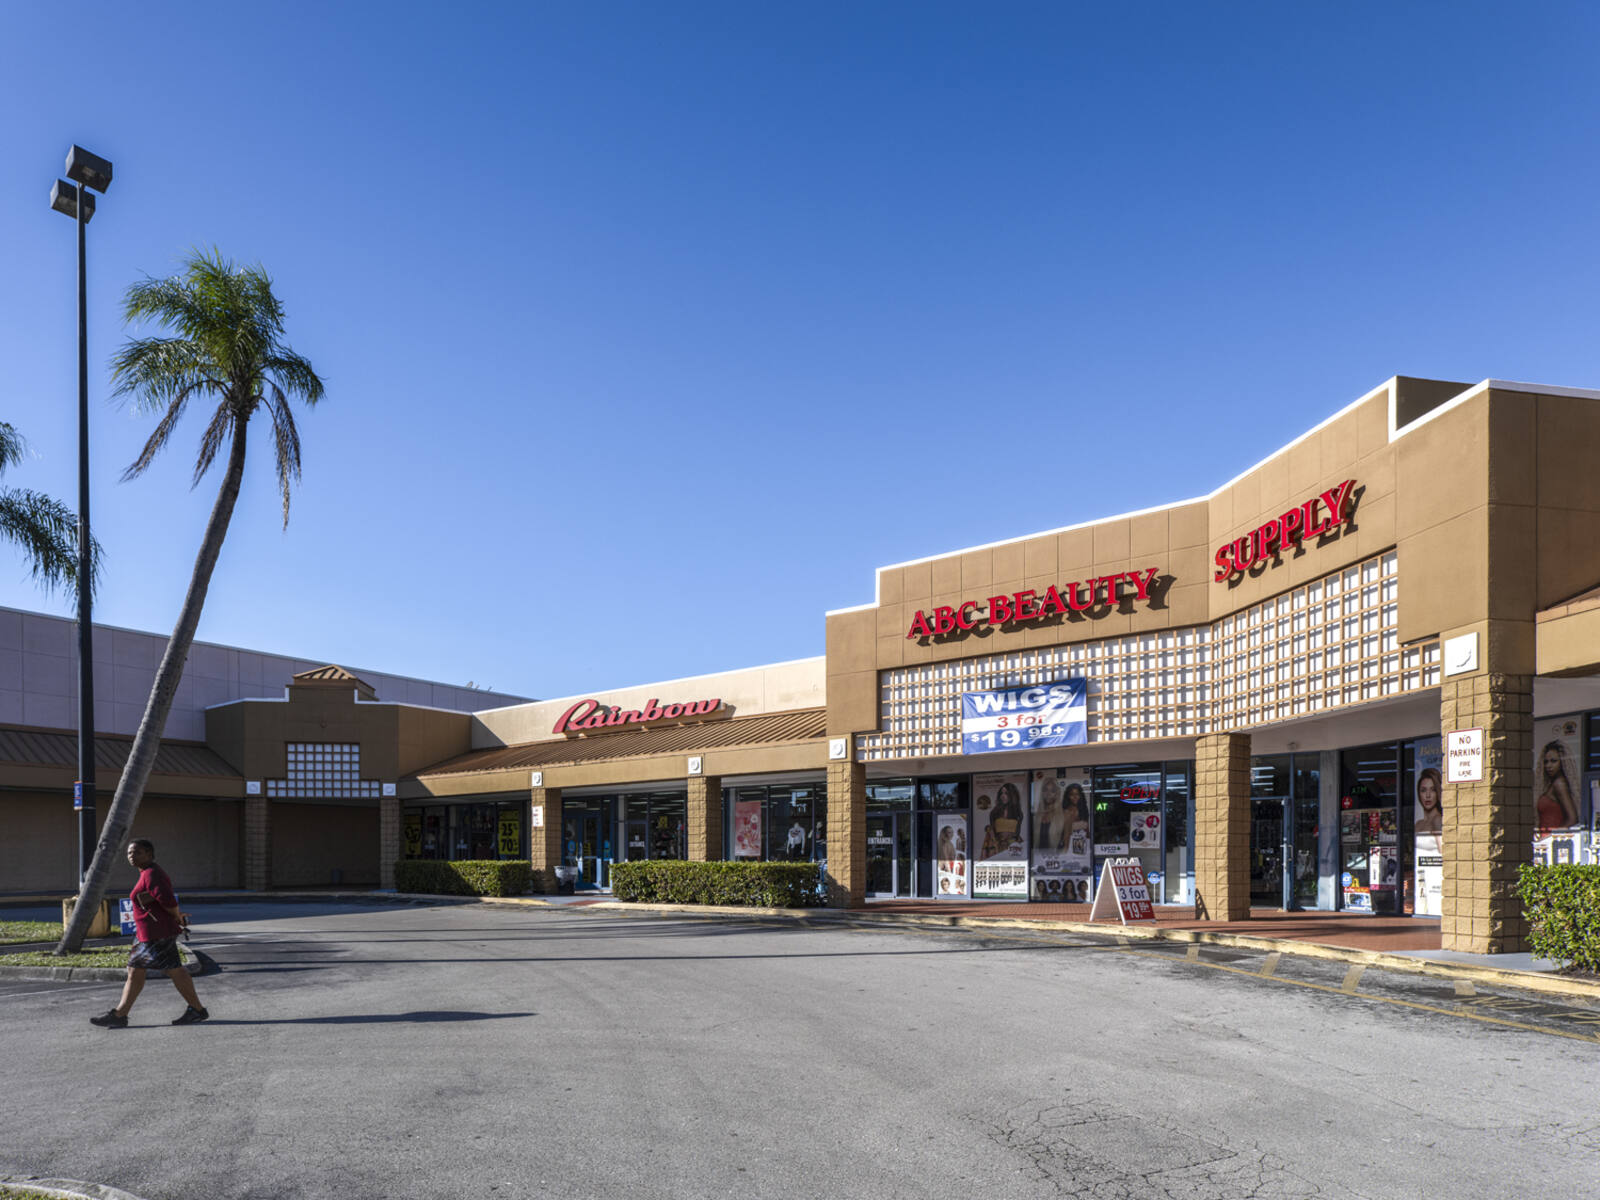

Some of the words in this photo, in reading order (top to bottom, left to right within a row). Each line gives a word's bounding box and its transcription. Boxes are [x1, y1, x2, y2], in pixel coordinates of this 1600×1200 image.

[1215, 480, 1357, 583] SUPPLY
[906, 601, 978, 639] ABC
[987, 567, 1159, 625] BEAUTY
[973, 685, 1072, 713] WIGS
[552, 698, 722, 734] Rainbow
[997, 716, 1009, 728] 3
[1016, 713, 1047, 727] for
[1459, 735, 1471, 744] NO
[1450, 747, 1481, 758] PARKING
[1121, 786, 1161, 800] OPEN
[1113, 867, 1144, 885] WIGS
[1120, 888, 1127, 899] 3
[1129, 887, 1145, 899] for
